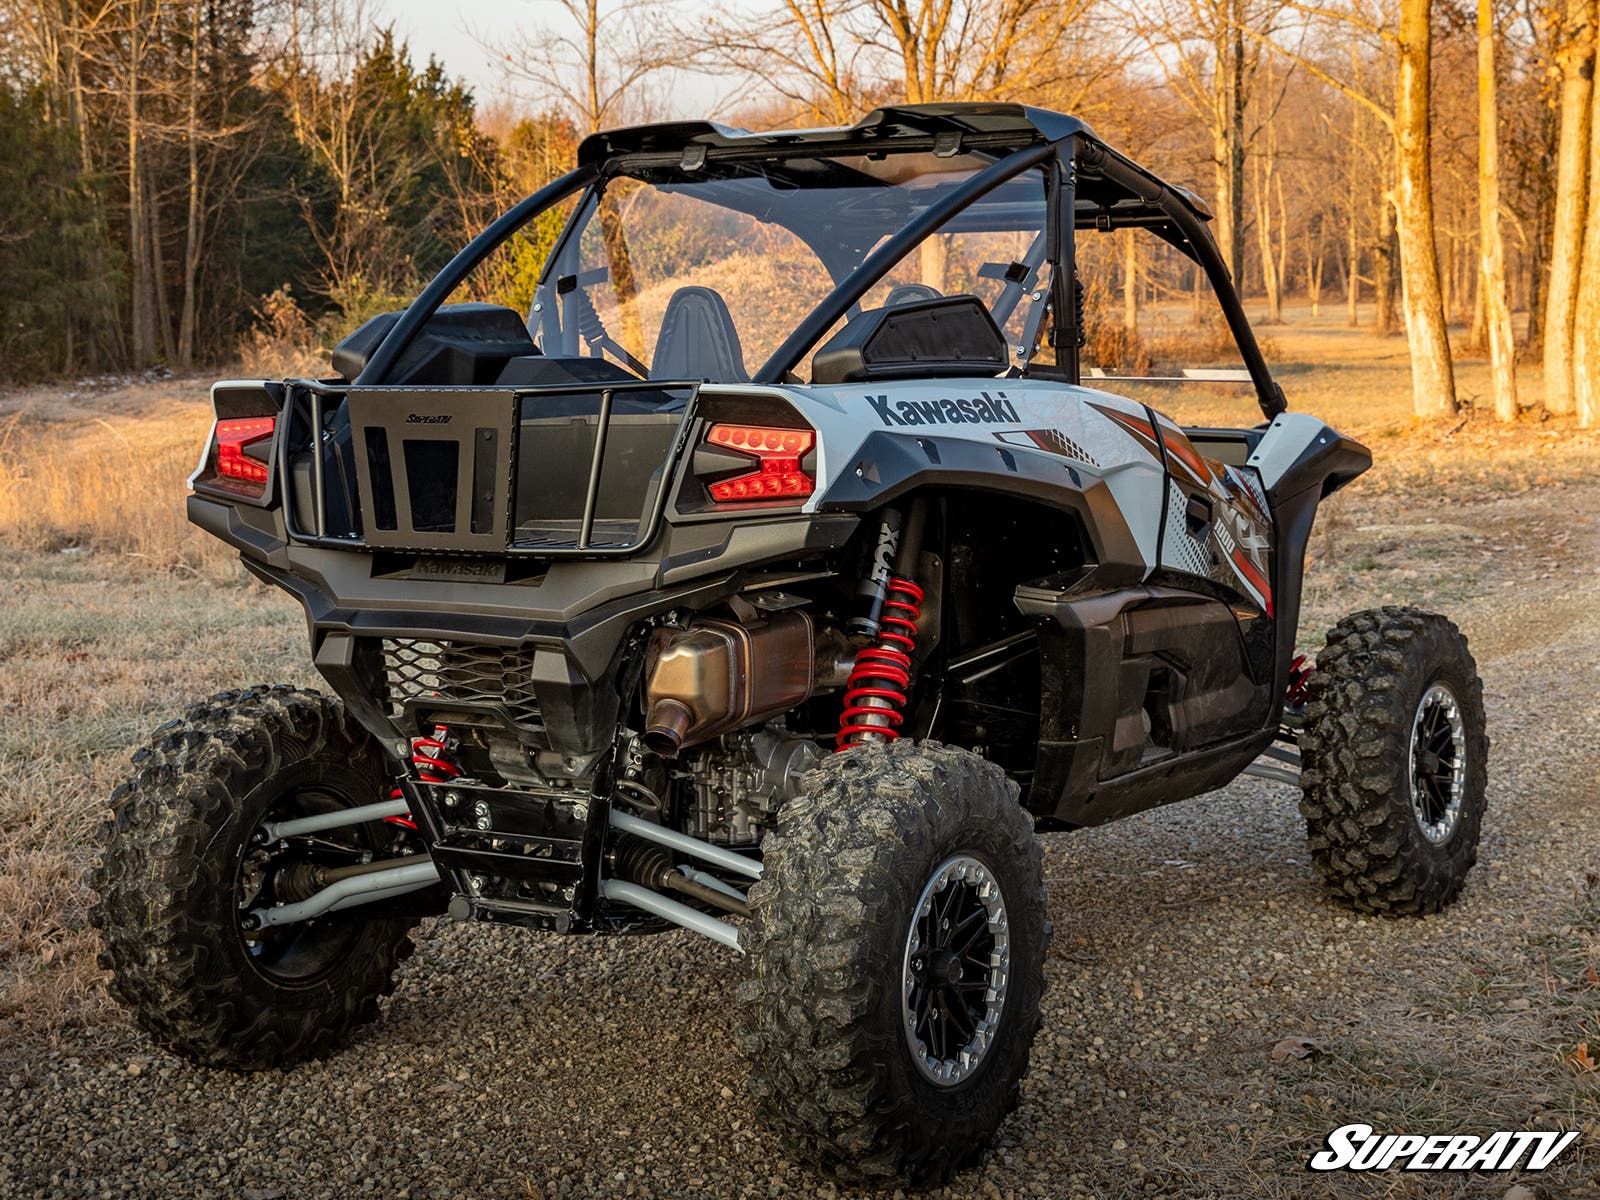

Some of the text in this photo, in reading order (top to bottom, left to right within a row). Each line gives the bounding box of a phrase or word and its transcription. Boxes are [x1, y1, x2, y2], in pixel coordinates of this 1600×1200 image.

[864, 391, 1022, 426] Kawasaki
[1214, 517, 1237, 554] 1000
[417, 560, 501, 577] Kawasaki
[871, 522, 900, 587] FOX
